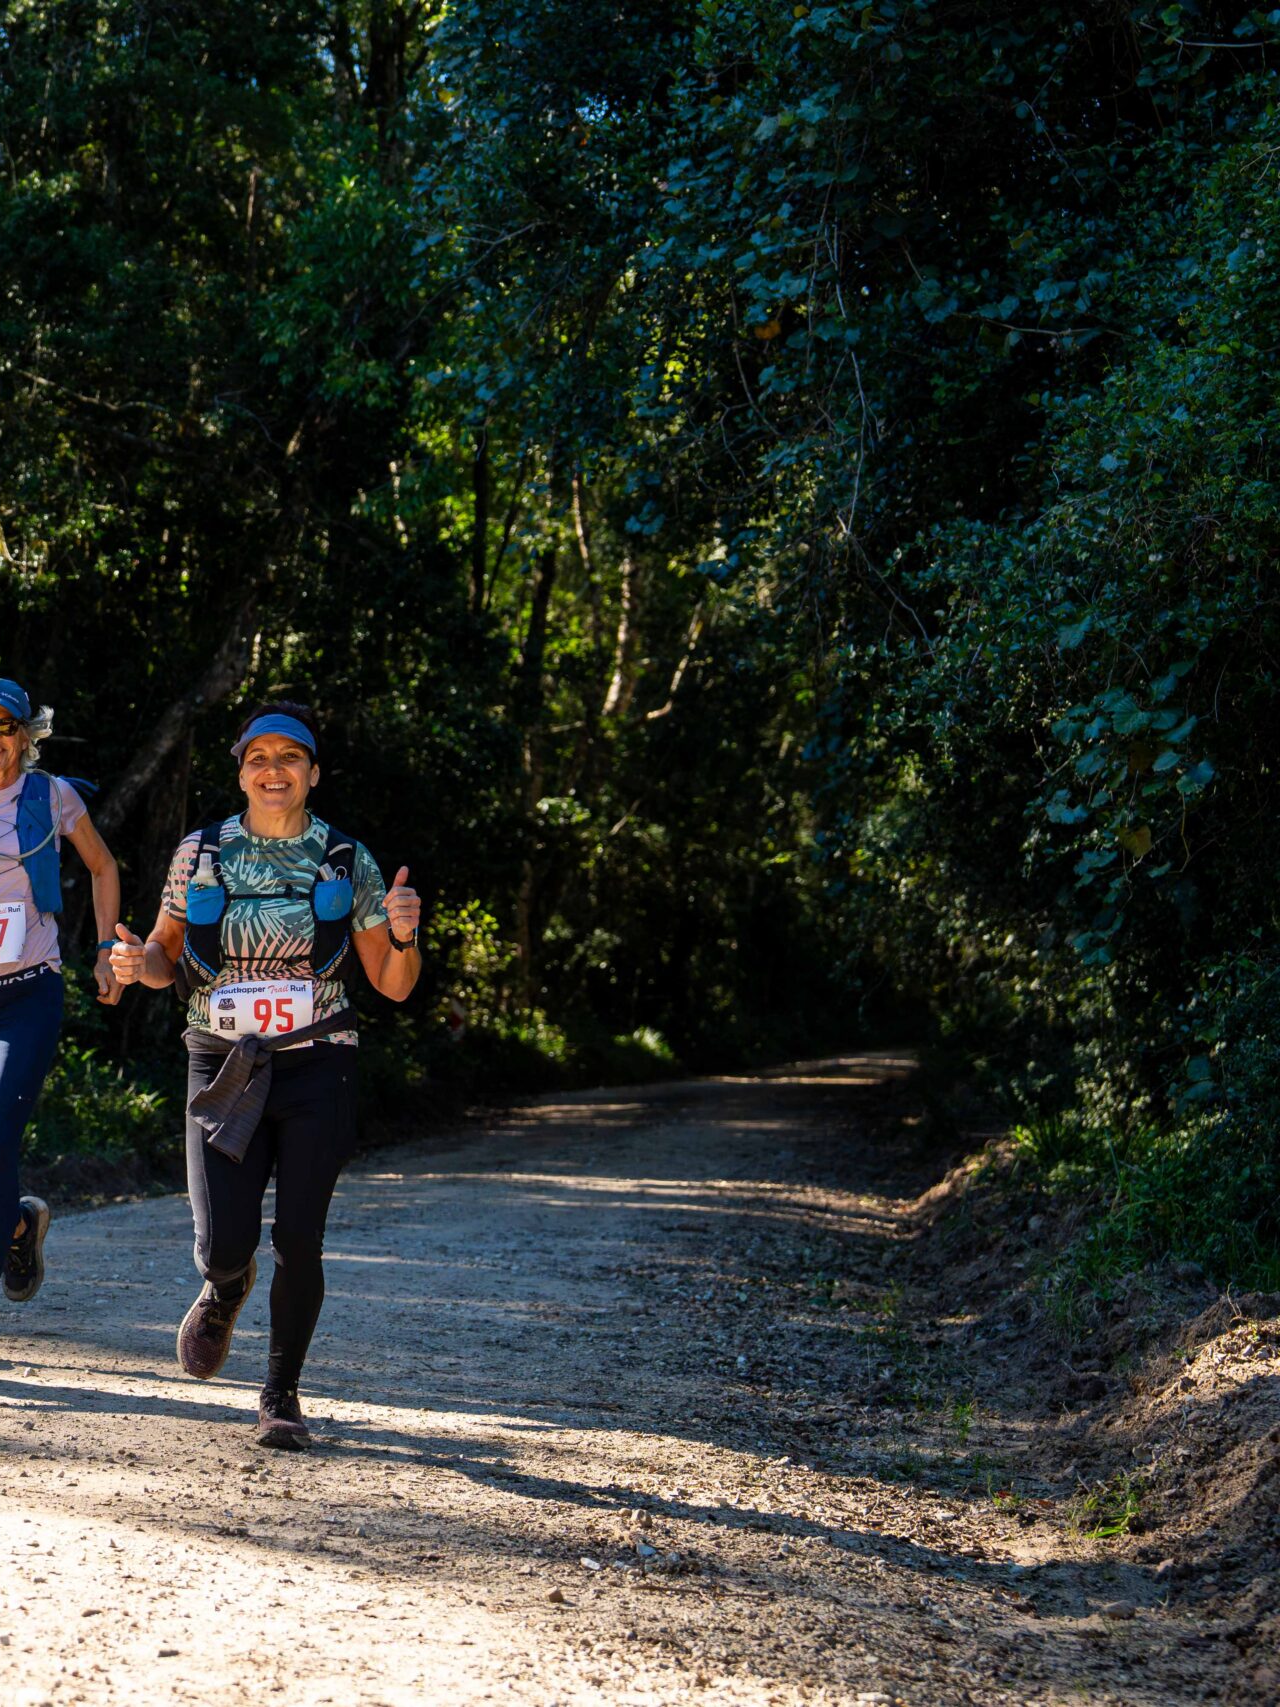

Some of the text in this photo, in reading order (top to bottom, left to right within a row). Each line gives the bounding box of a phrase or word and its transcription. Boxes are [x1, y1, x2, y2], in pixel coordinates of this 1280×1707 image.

[217, 986, 266, 995] Houtkapper
[268, 984, 289, 994] Trail
[253, 998, 293, 1033] 95
